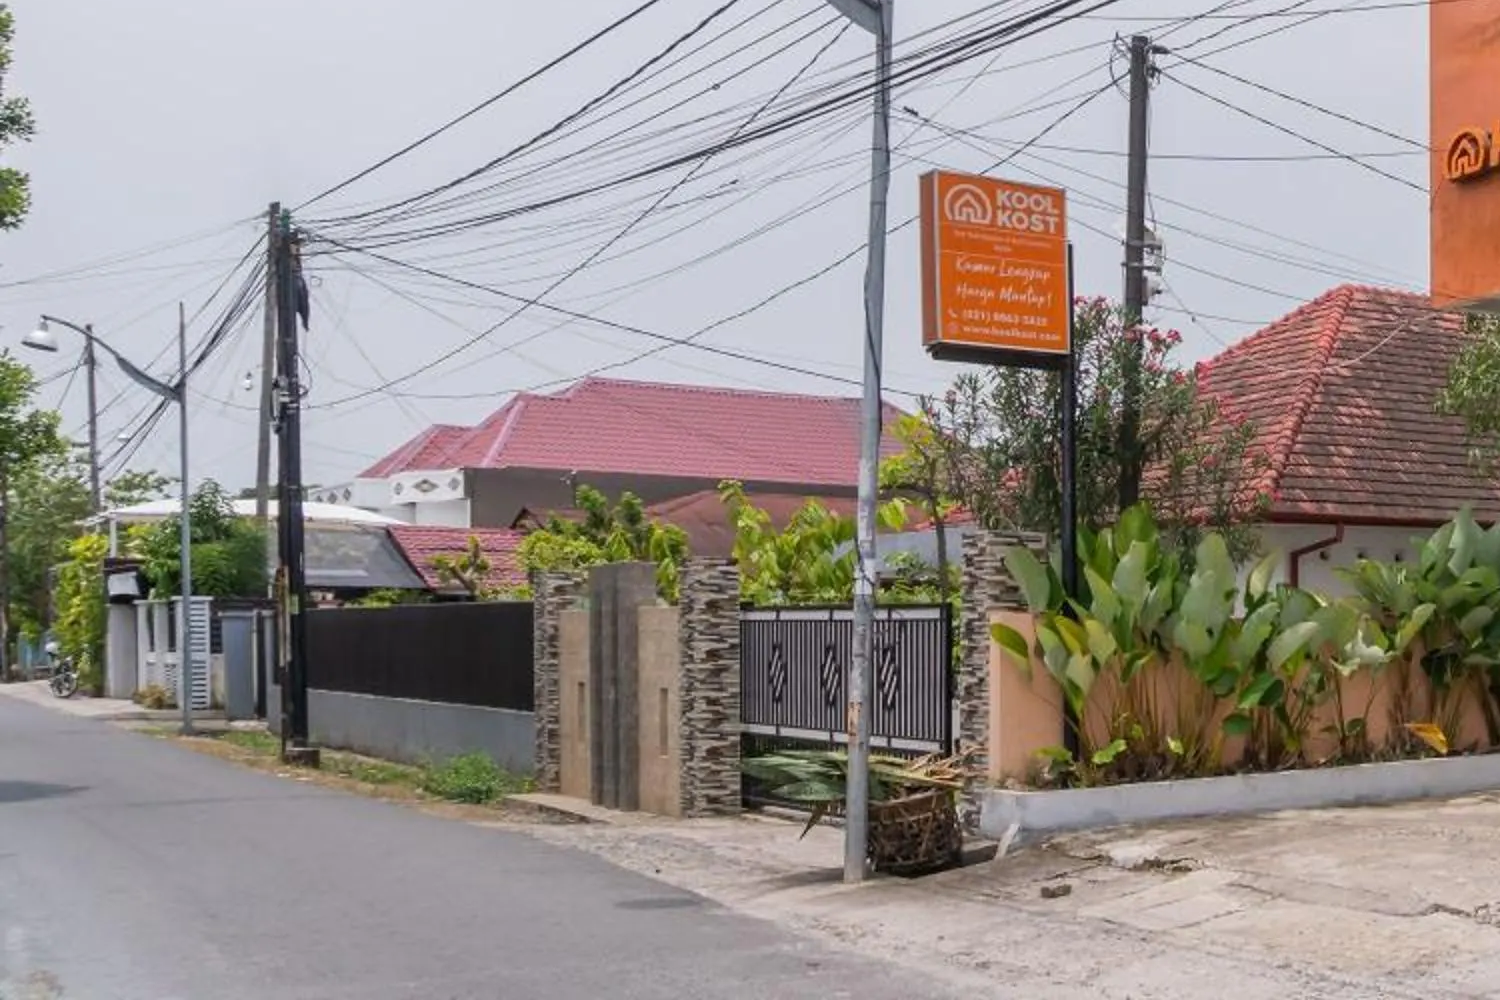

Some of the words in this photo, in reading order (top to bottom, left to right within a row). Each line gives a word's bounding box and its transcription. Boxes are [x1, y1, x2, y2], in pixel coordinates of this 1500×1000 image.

[996, 189, 1060, 214] KOOL
[996, 211, 1060, 234] KOST
[956, 282, 995, 304] Harga
